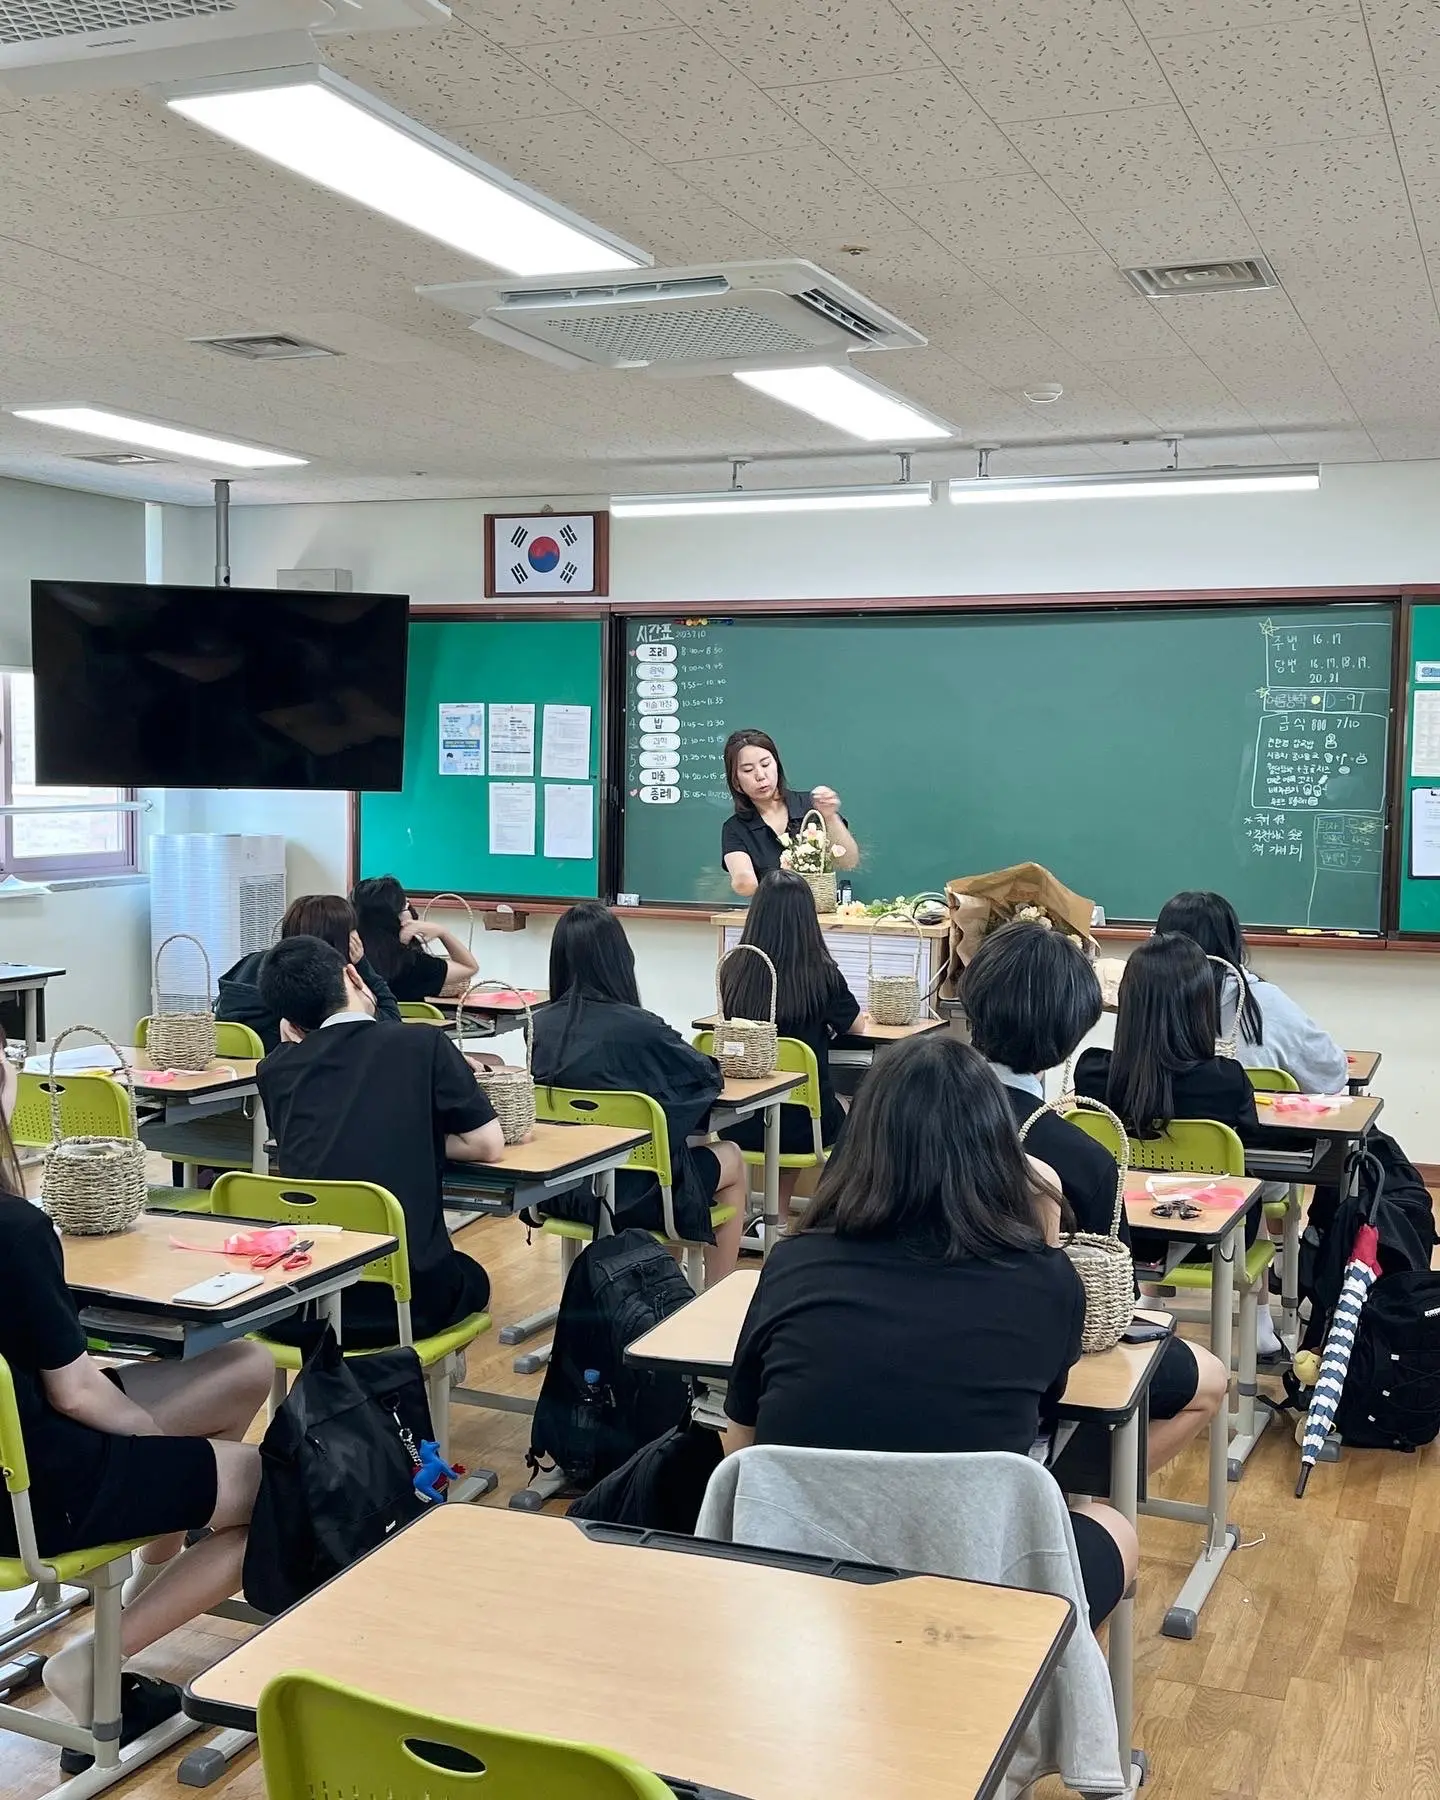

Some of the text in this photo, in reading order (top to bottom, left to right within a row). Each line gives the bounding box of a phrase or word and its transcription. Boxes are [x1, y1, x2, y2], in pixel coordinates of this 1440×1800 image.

[636, 623, 675, 642] 시간표
[649, 647, 668, 657] 조례
[654, 718, 664, 729] 밥
[1280, 716, 1360, 732] 급식 7/10
[651, 770, 666, 782] 미술
[651, 787, 671, 801] 종례
